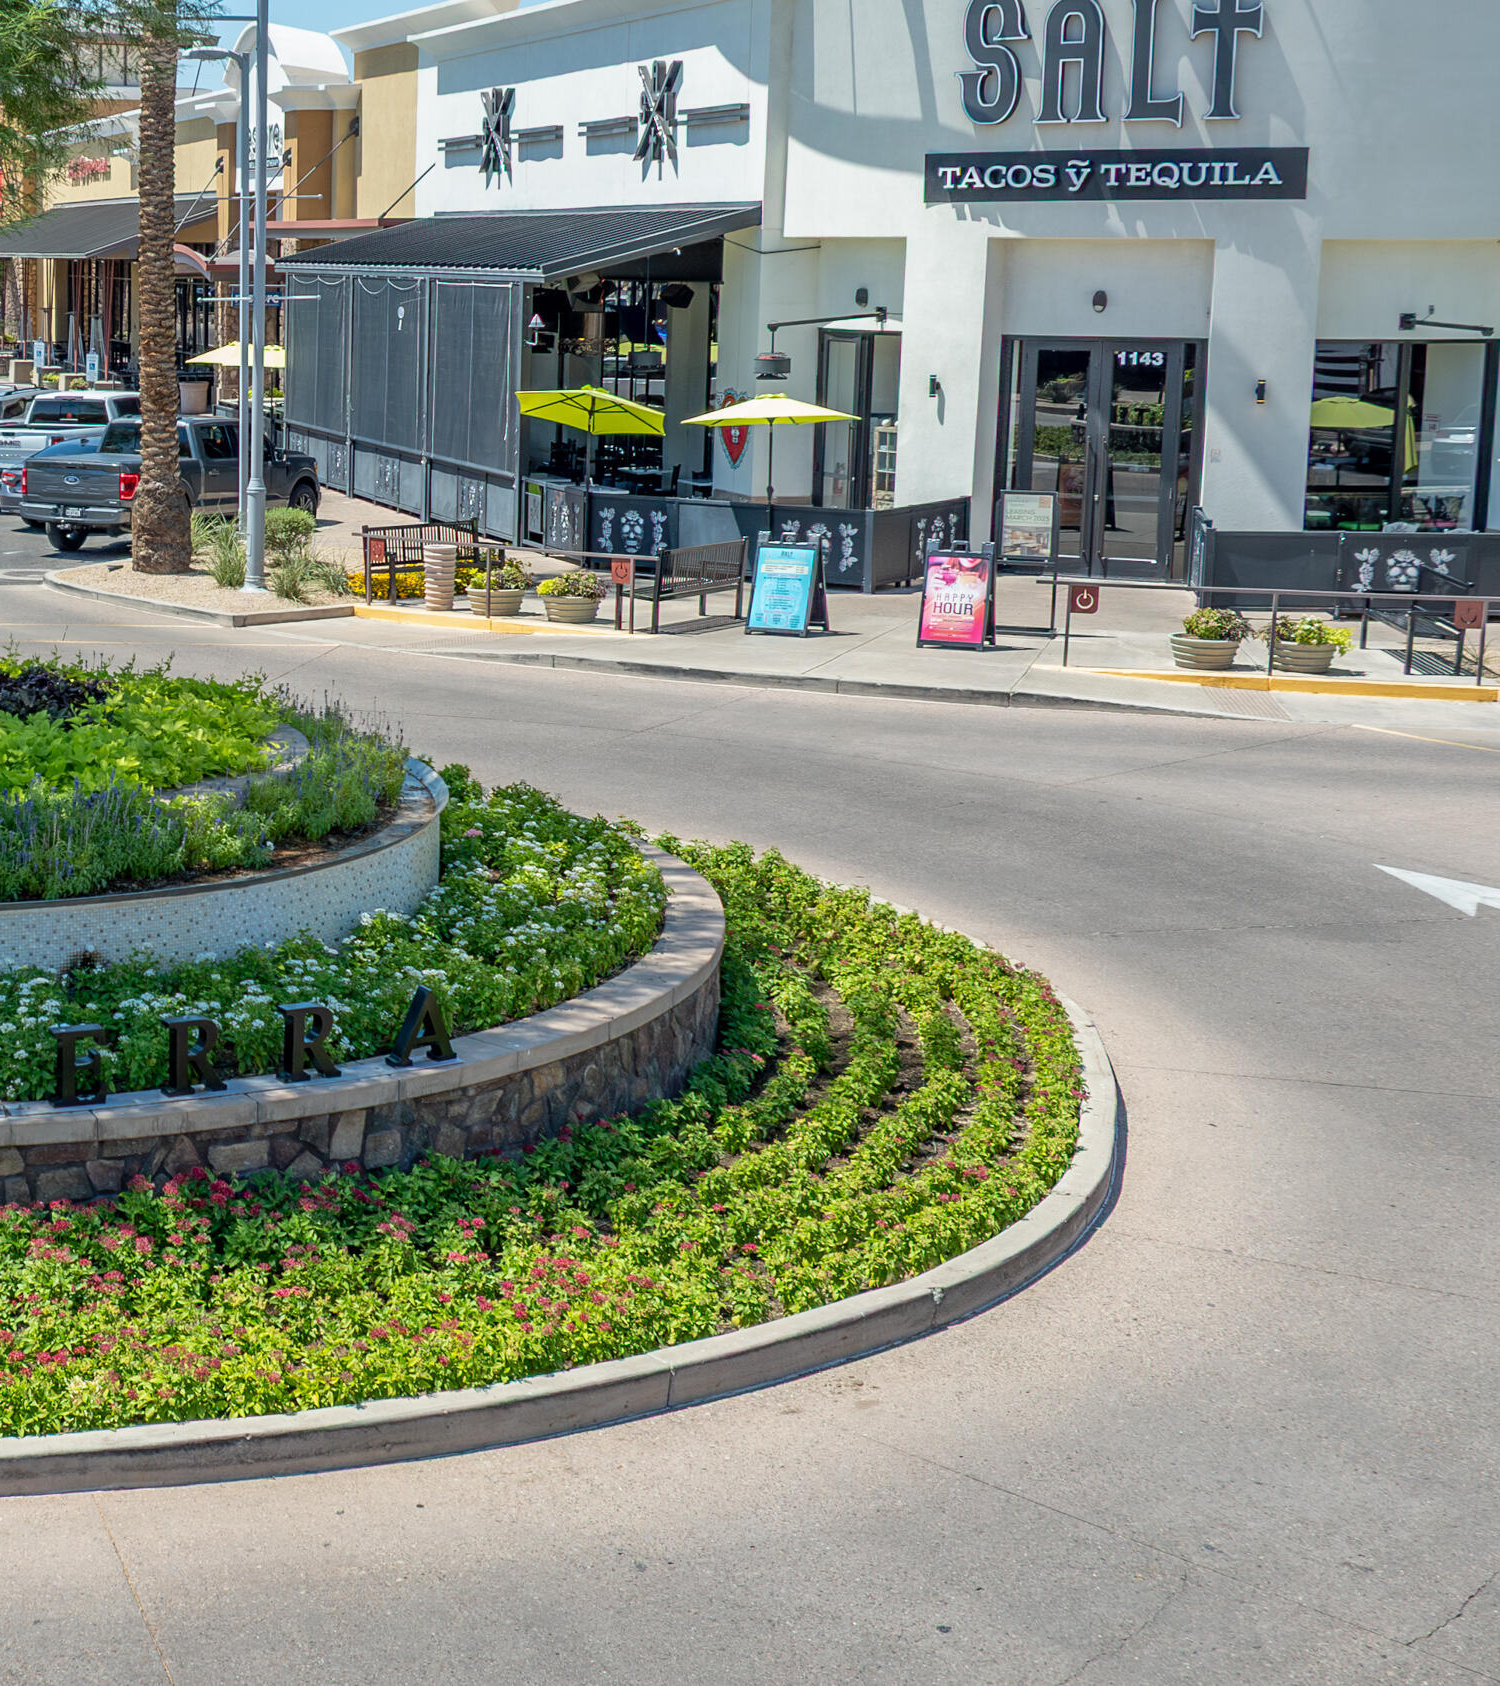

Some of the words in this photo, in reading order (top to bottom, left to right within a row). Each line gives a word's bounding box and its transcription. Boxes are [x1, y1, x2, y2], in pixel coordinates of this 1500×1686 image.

[953, 0, 1265, 128] SALT
[937, 164, 1057, 190] TACOS
[1100, 161, 1283, 189] TEQUILA
[1117, 351, 1164, 366] 1143
[936, 592, 974, 602] HAPPY
[932, 601, 974, 616] HOUR
